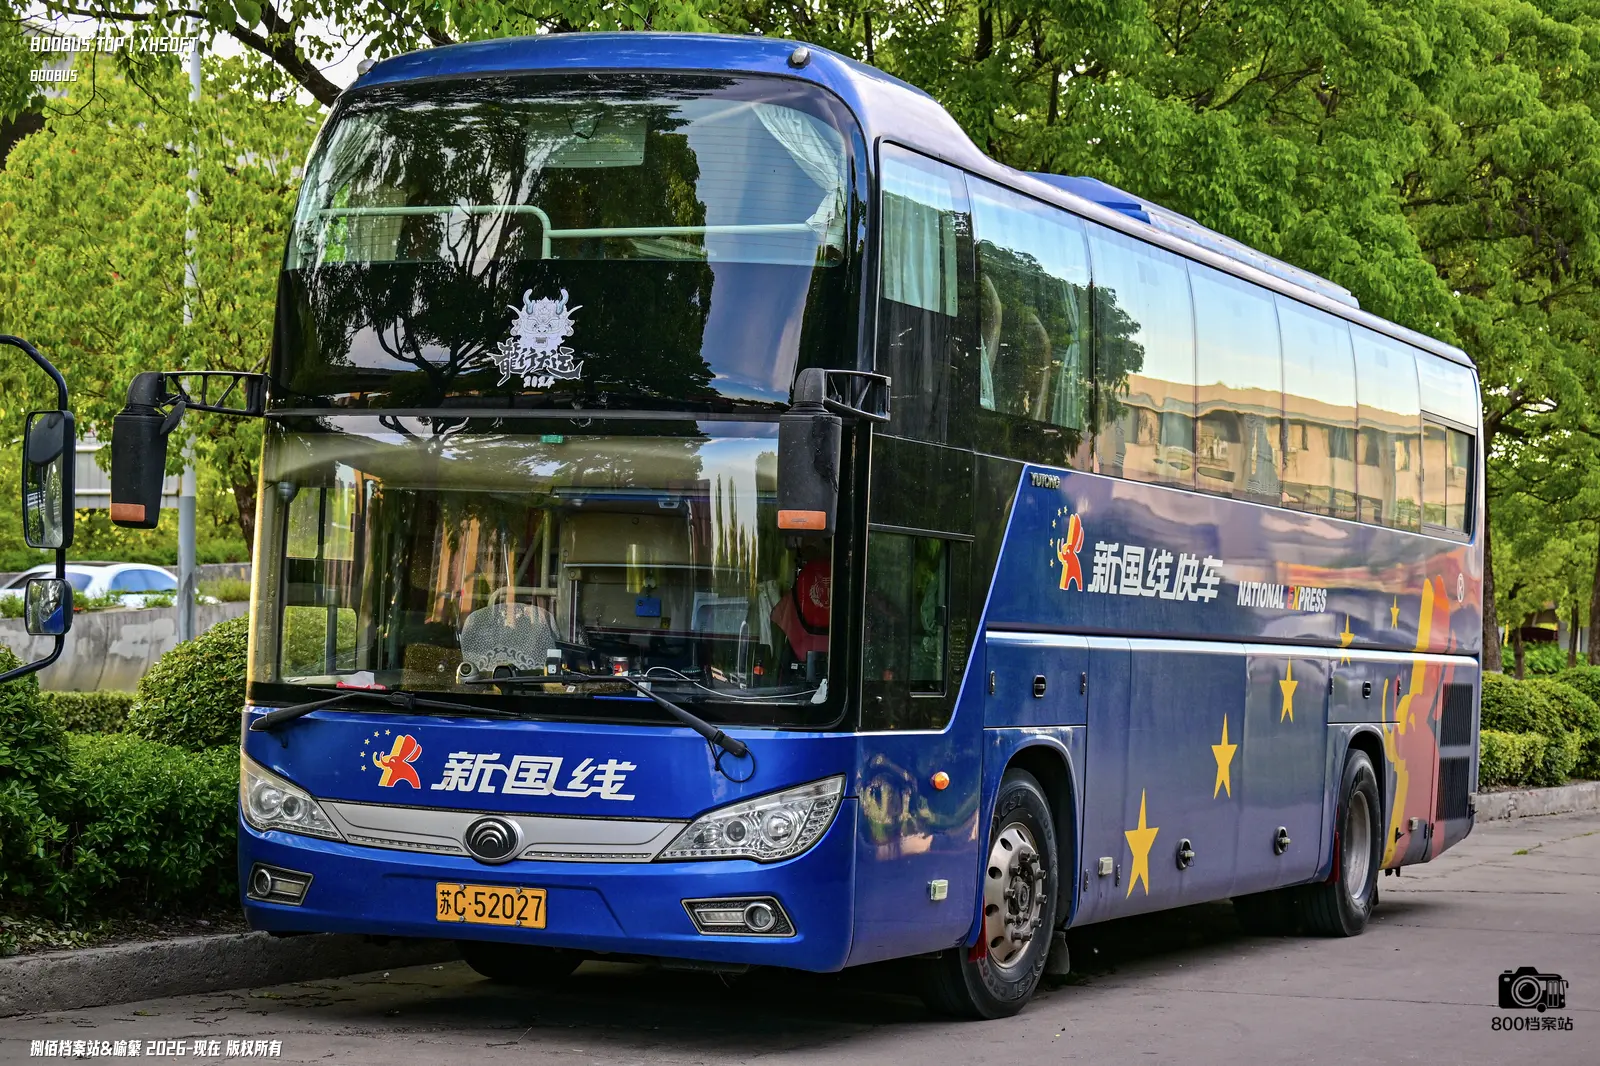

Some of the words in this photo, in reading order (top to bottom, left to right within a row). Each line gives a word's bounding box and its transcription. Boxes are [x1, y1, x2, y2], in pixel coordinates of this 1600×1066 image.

[1029, 472, 1061, 489] YUTONG
[1087, 541, 1224, 603] 新国线快车
[1236, 580, 1285, 610] NATIONAL
[1287, 585, 1328, 613] EXPRESS
[431, 751, 638, 801] 新国线
